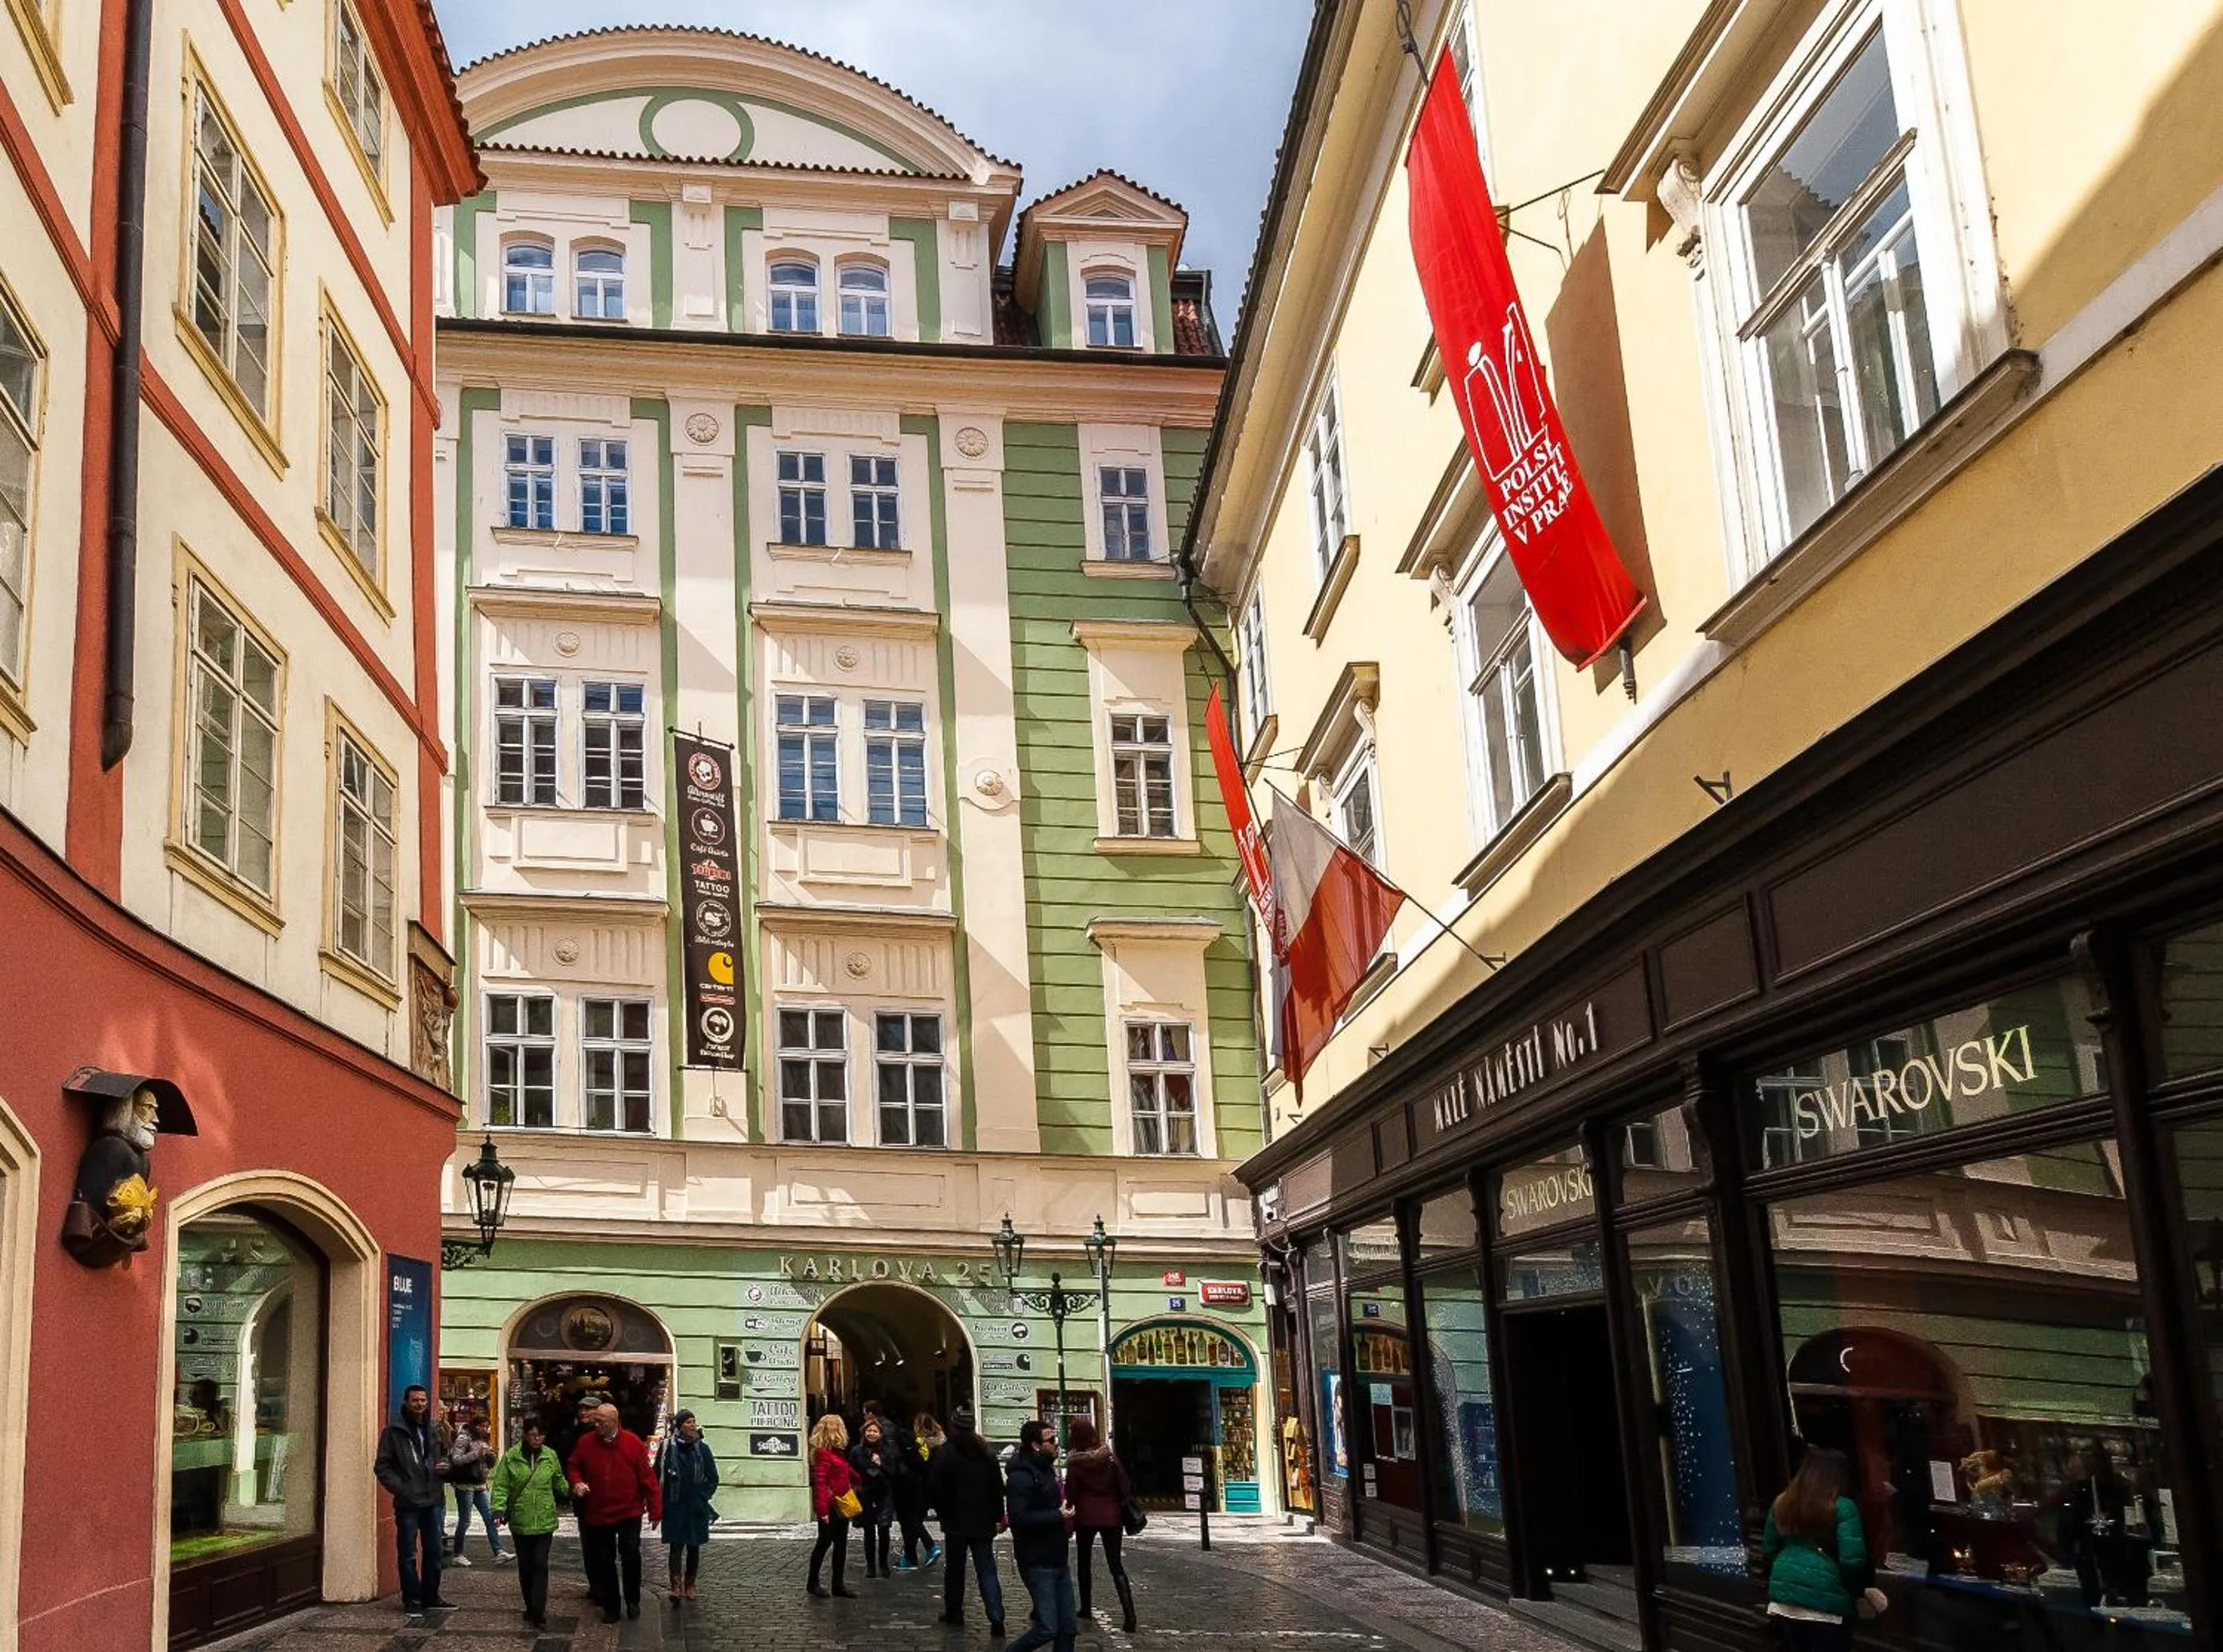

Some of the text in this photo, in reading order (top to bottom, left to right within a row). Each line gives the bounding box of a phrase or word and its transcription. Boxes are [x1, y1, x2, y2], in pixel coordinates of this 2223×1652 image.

[1513, 521, 1528, 545] V
[695, 880, 730, 894] TATTOO
[1796, 1025, 2038, 1138] SWAROVSKI
[1434, 1071, 1468, 1133] MALÉ
[779, 1256, 993, 1284] KARLOVA 25
[394, 1274, 413, 1293] BLUE
[1207, 1286, 1243, 1295] KARLOVA
[1172, 1298, 1181, 1308] 25
[750, 1401, 797, 1416] TATTOO
[751, 1417, 798, 1427] PIERCING
